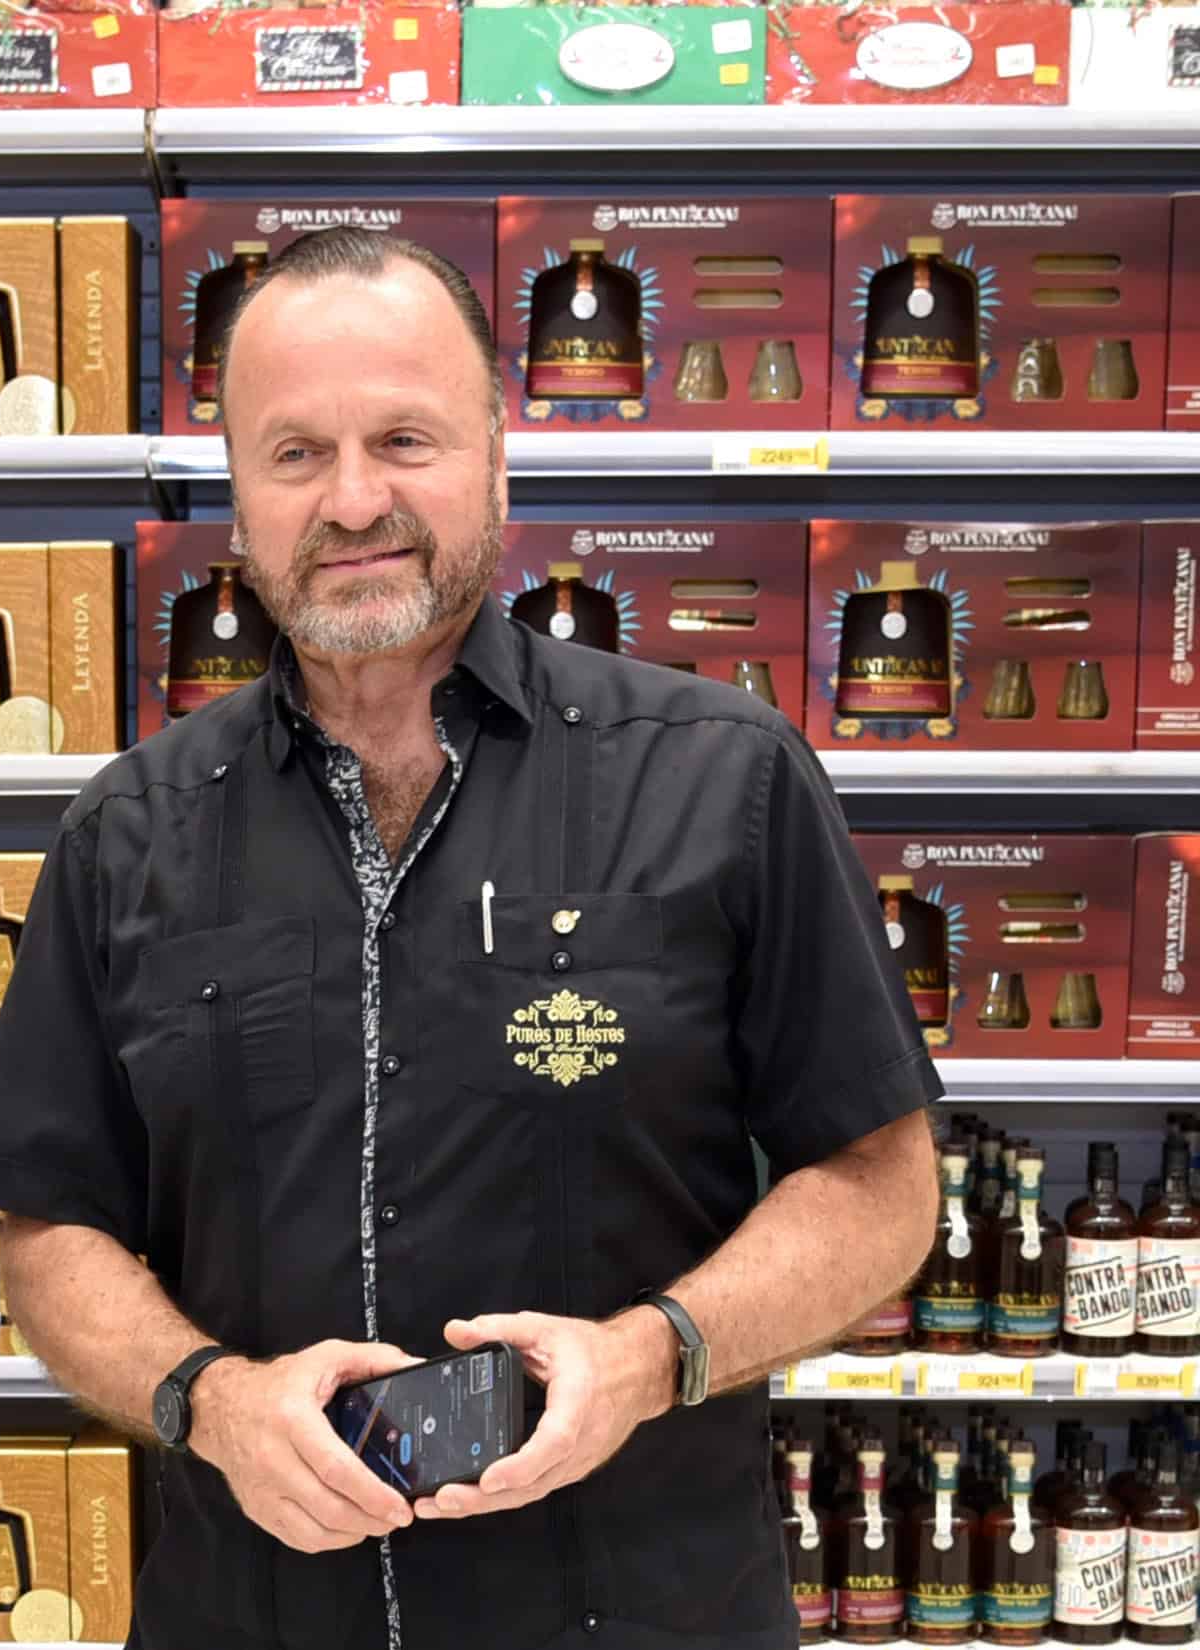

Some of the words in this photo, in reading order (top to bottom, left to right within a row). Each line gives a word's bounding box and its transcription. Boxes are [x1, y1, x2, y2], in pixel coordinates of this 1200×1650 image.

[282, 208, 312, 223] RON
[619, 207, 651, 221] RON
[957, 205, 992, 219] RON
[84, 269, 101, 371] LEYENDA
[596, 532, 627, 545] RON
[931, 533, 963, 545] RON
[72, 592, 89, 692] LEYENDA
[928, 847, 957, 859] RON
[506, 1024, 551, 1043] PUROS
[576, 1024, 625, 1043] HOSTOS
[1065, 1264, 1126, 1297] CONTRA
[1072, 1287, 1132, 1321] -BANDO
[91, 1496, 108, 1585] LEYENDA
